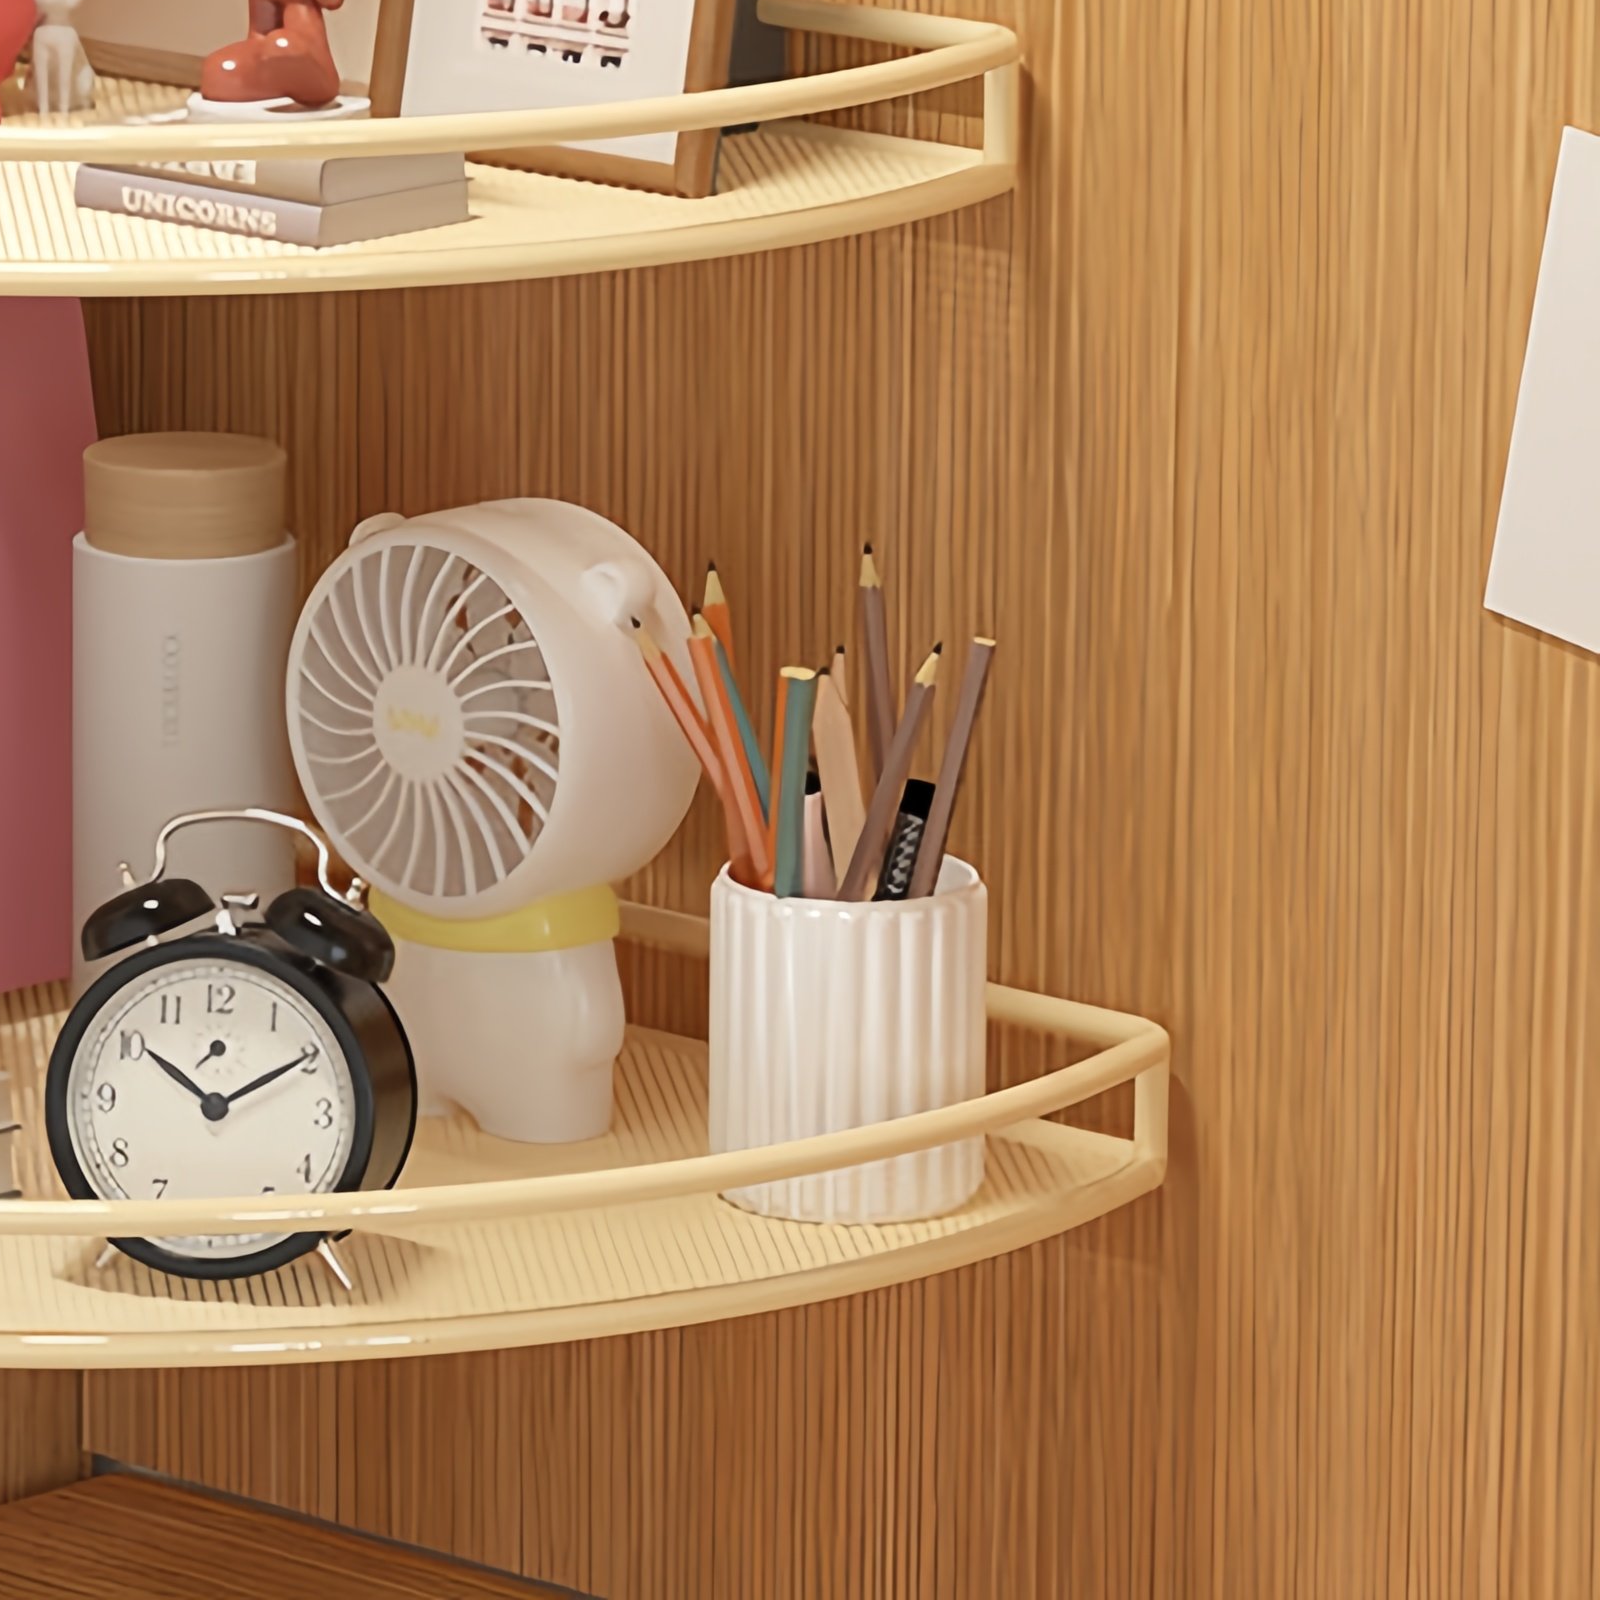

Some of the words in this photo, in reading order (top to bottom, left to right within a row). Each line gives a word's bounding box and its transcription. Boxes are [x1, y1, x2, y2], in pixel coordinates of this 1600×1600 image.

[121, 186, 277, 237] UNICORNS
[159, 994, 182, 1025] 11
[206, 983, 236, 1015] 12
[119, 1030, 146, 1061] 10
[96, 1082, 116, 1113] 9
[313, 1097, 334, 1129] 3
[109, 1137, 129, 1168] 8
[296, 1153, 312, 1183] 4
